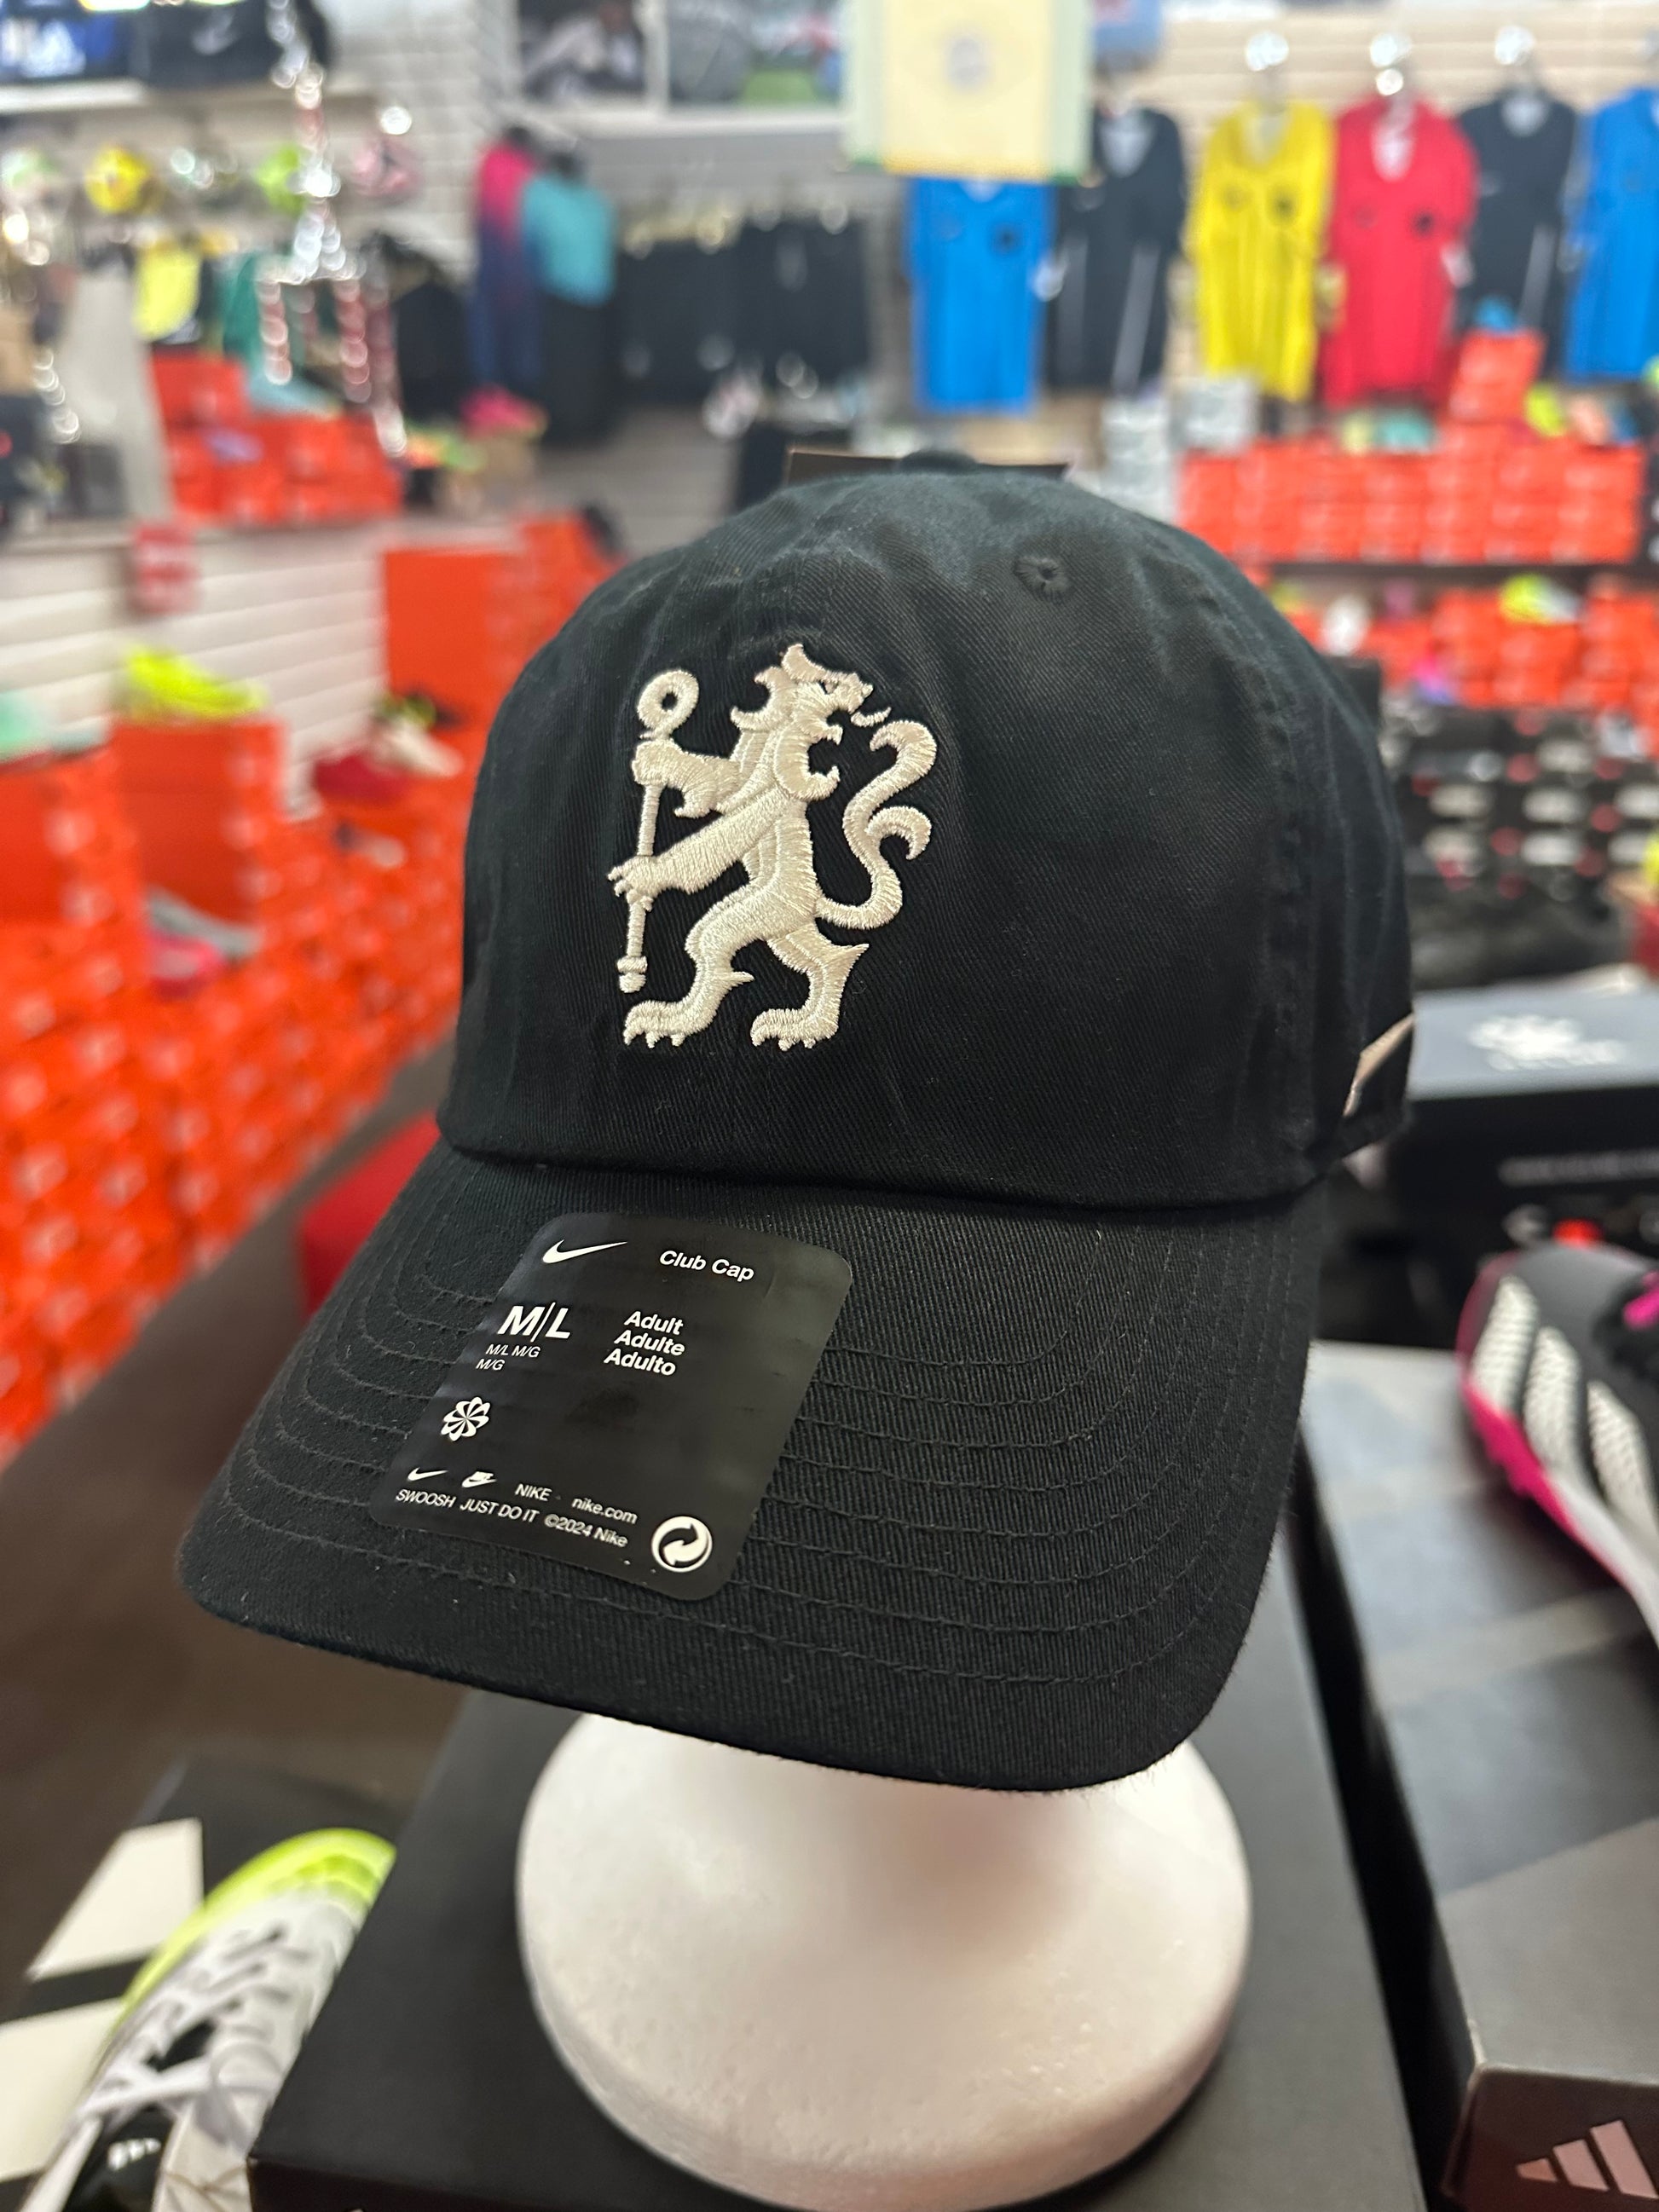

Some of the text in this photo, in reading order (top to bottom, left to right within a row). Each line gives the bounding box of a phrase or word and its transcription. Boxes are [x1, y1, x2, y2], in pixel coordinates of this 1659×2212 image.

[660, 1250, 754, 1282] Club Cap
[624, 1311, 684, 1335] Adult
[485, 1344, 541, 1358] M/L M/G
[614, 1330, 685, 1356] Adulte
[476, 1359, 505, 1371] M/G
[604, 1349, 676, 1376] Adulto
[515, 1483, 638, 1524] NIKE nike.com
[396, 1489, 456, 1508] SWOOSH
[460, 1499, 499, 1515] JUST
[498, 1505, 522, 1520] DO
[523, 1510, 540, 1523] IT
[594, 1527, 628, 1547] Nike
